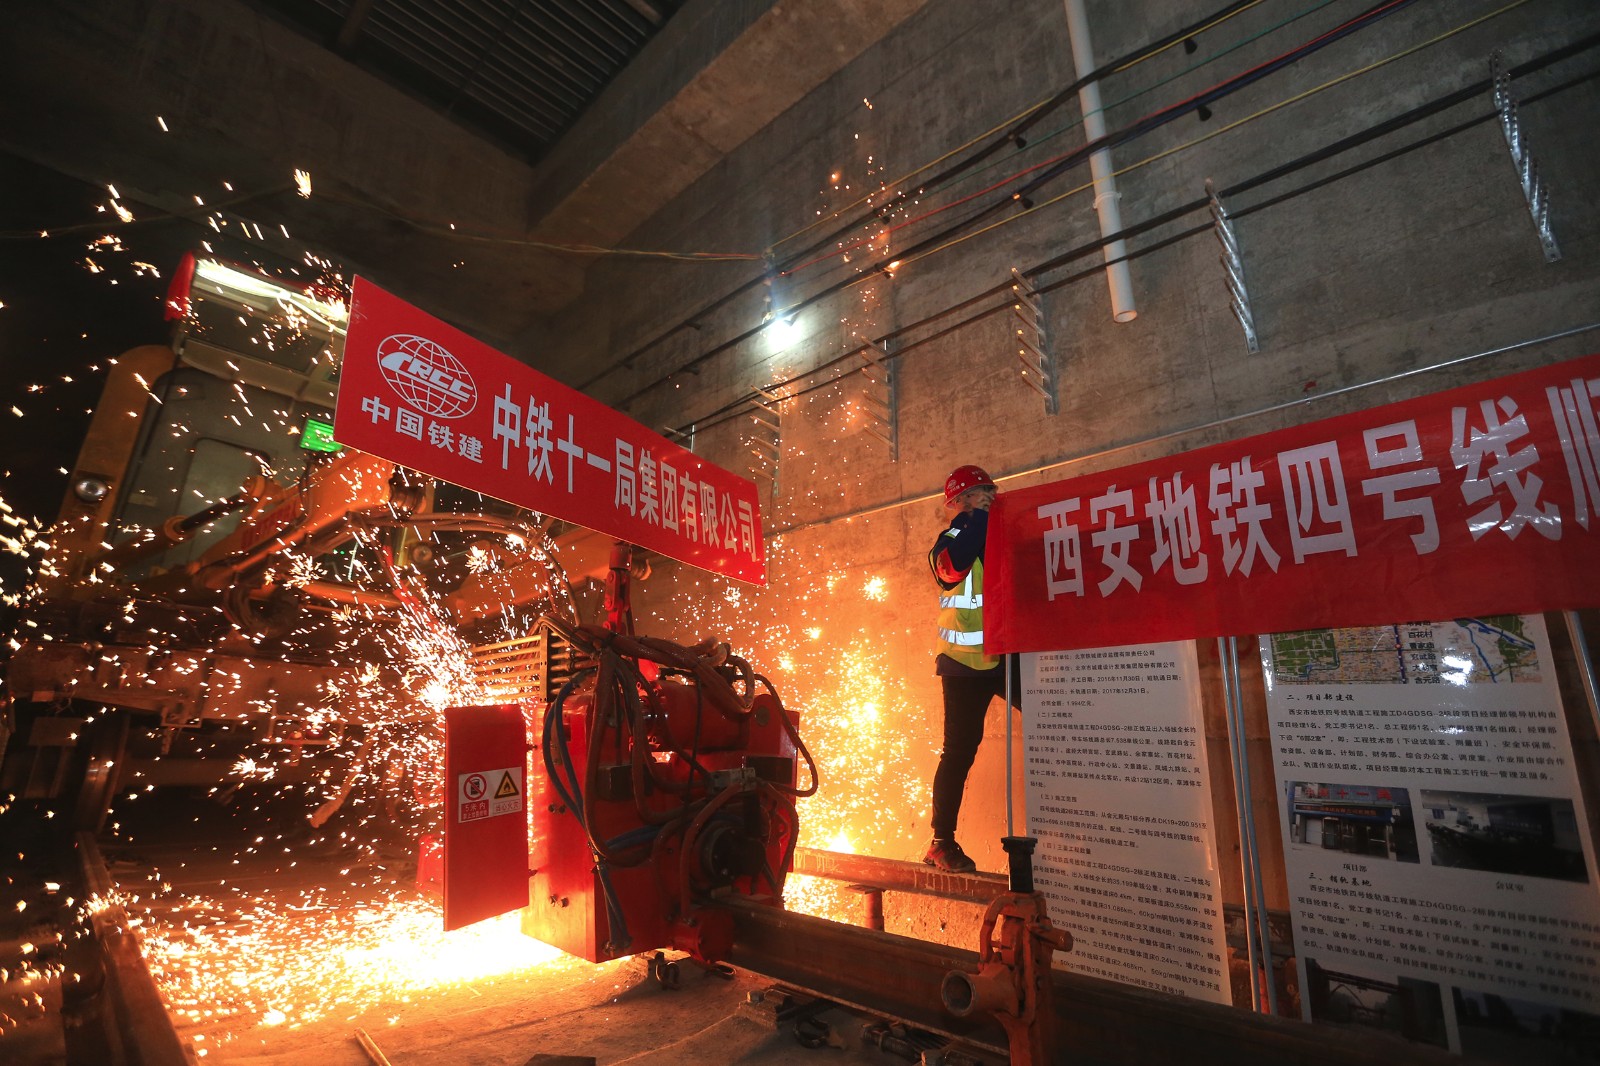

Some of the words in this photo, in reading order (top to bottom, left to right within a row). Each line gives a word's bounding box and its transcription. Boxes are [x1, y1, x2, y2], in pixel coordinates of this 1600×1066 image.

[381, 352, 473, 403] CRCC
[361, 396, 485, 465] 中国铁建
[492, 383, 757, 563] 中铁十一局集团有限公司
[1408, 630, 1433, 638] 百花村
[1414, 676, 1441, 684] 含元路
[1343, 862, 1368, 873] 项目部
